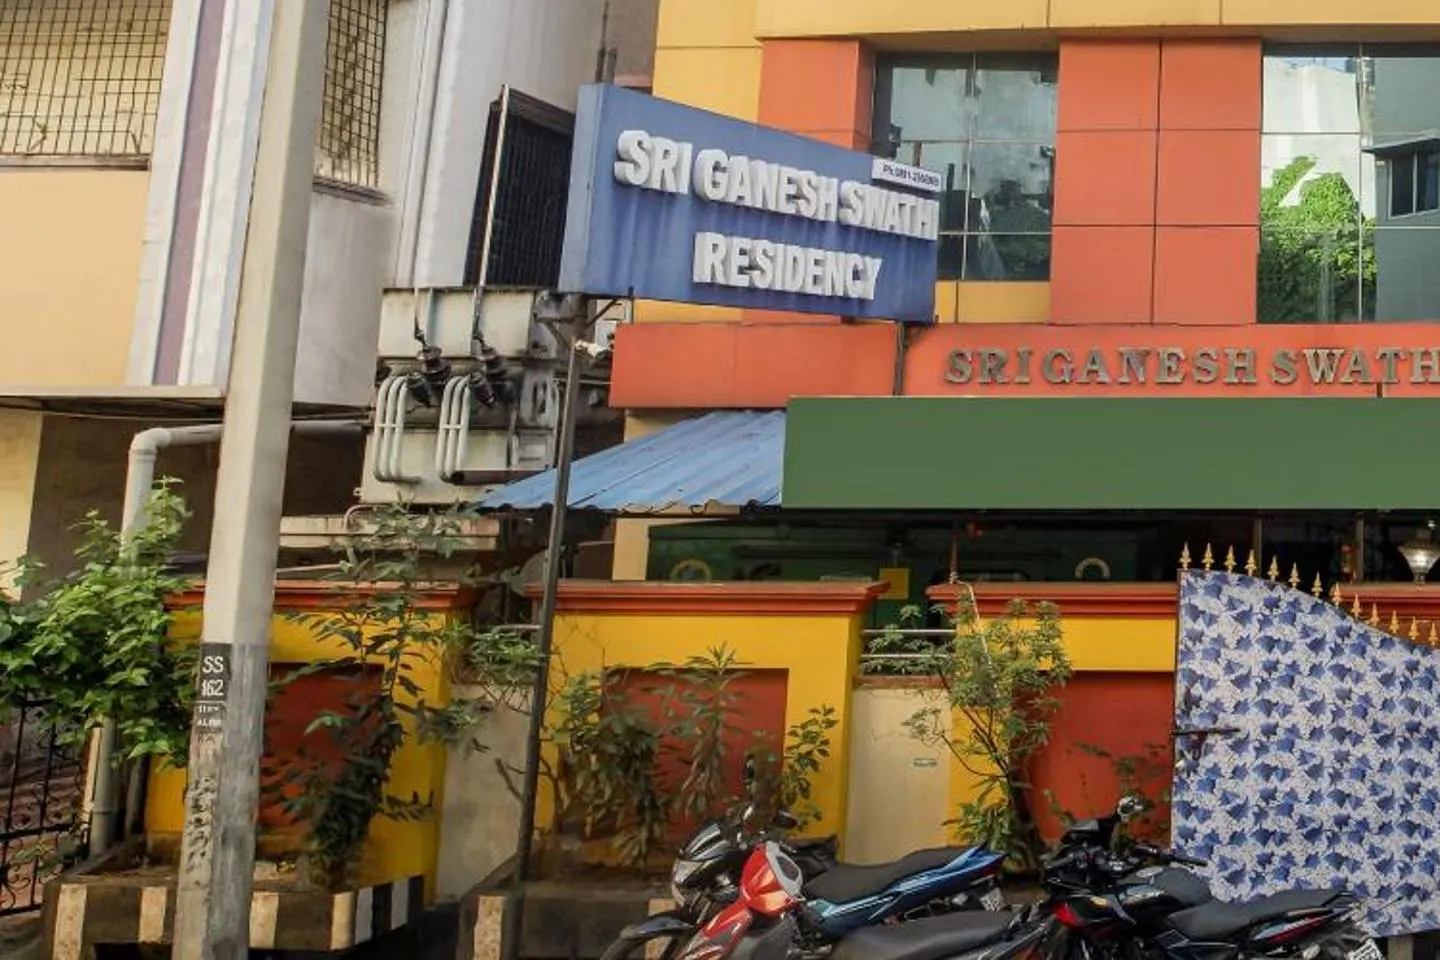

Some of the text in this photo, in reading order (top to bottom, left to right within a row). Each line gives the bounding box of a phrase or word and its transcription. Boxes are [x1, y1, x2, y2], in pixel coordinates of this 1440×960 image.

[614, 130, 940, 241] SRI GANESH SWATHI
[693, 232, 883, 300] RESIDENCY
[945, 347, 1033, 385] SRI
[1043, 347, 1257, 385] GANESH
[202, 655, 224, 674] SS
